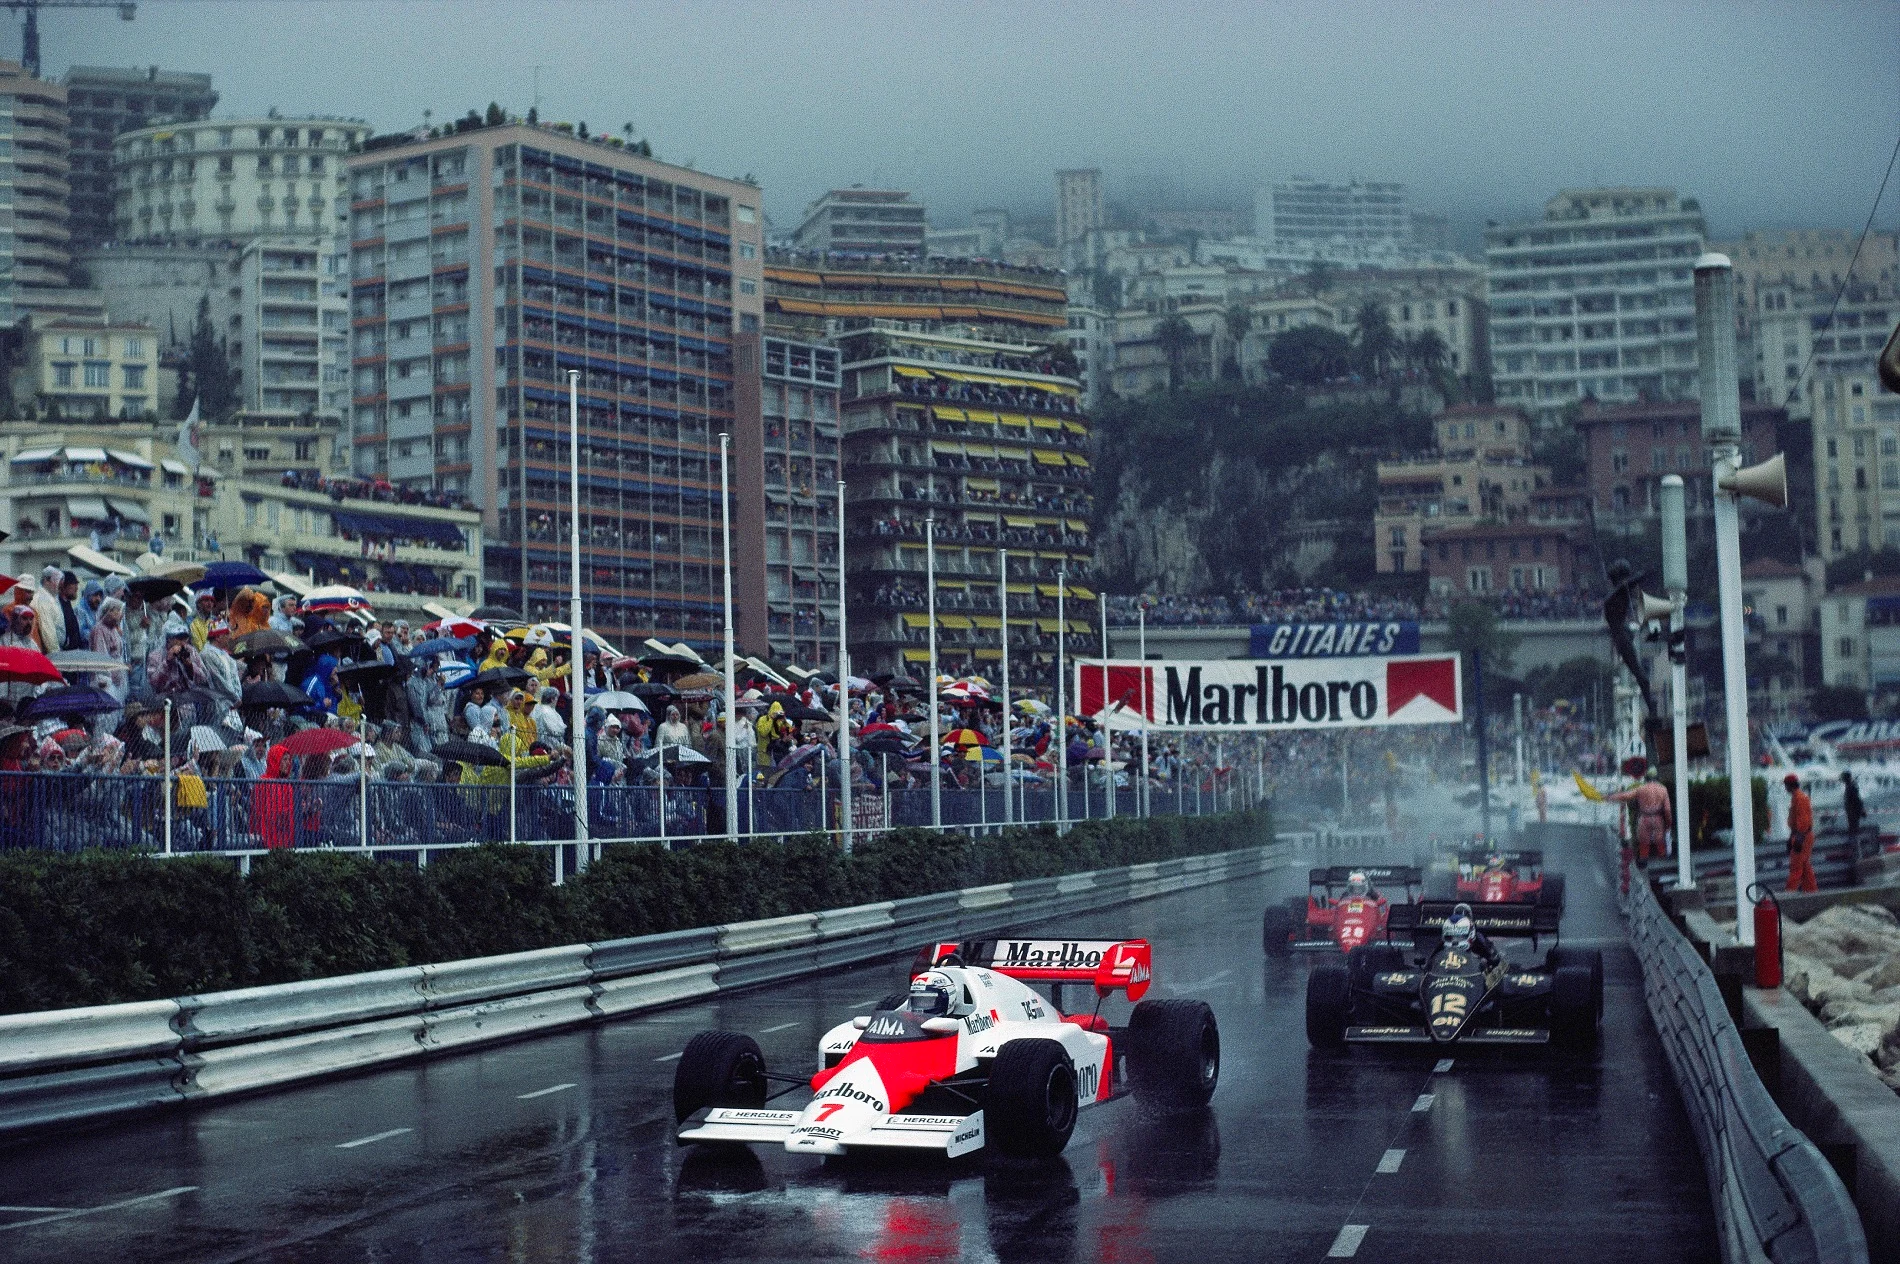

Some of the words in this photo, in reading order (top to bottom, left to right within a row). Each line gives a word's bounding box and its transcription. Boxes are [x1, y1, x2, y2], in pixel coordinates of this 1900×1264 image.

[1269, 623, 1400, 654] GITANES
[1165, 664, 1378, 726] Marlboro
[1341, 926, 1364, 938] 28
[1003, 943, 1107, 968] Marlbo
[1431, 993, 1467, 1015] 12
[963, 1013, 994, 1036] Marlboro
[813, 1082, 884, 1112] arlboro
[735, 1111, 794, 1119] HERCULES
[814, 1103, 845, 1122] 7
[903, 1117, 962, 1125] HERCULES
[791, 1126, 844, 1137] UNIPART
[955, 1127, 979, 1144] MICHELIN
